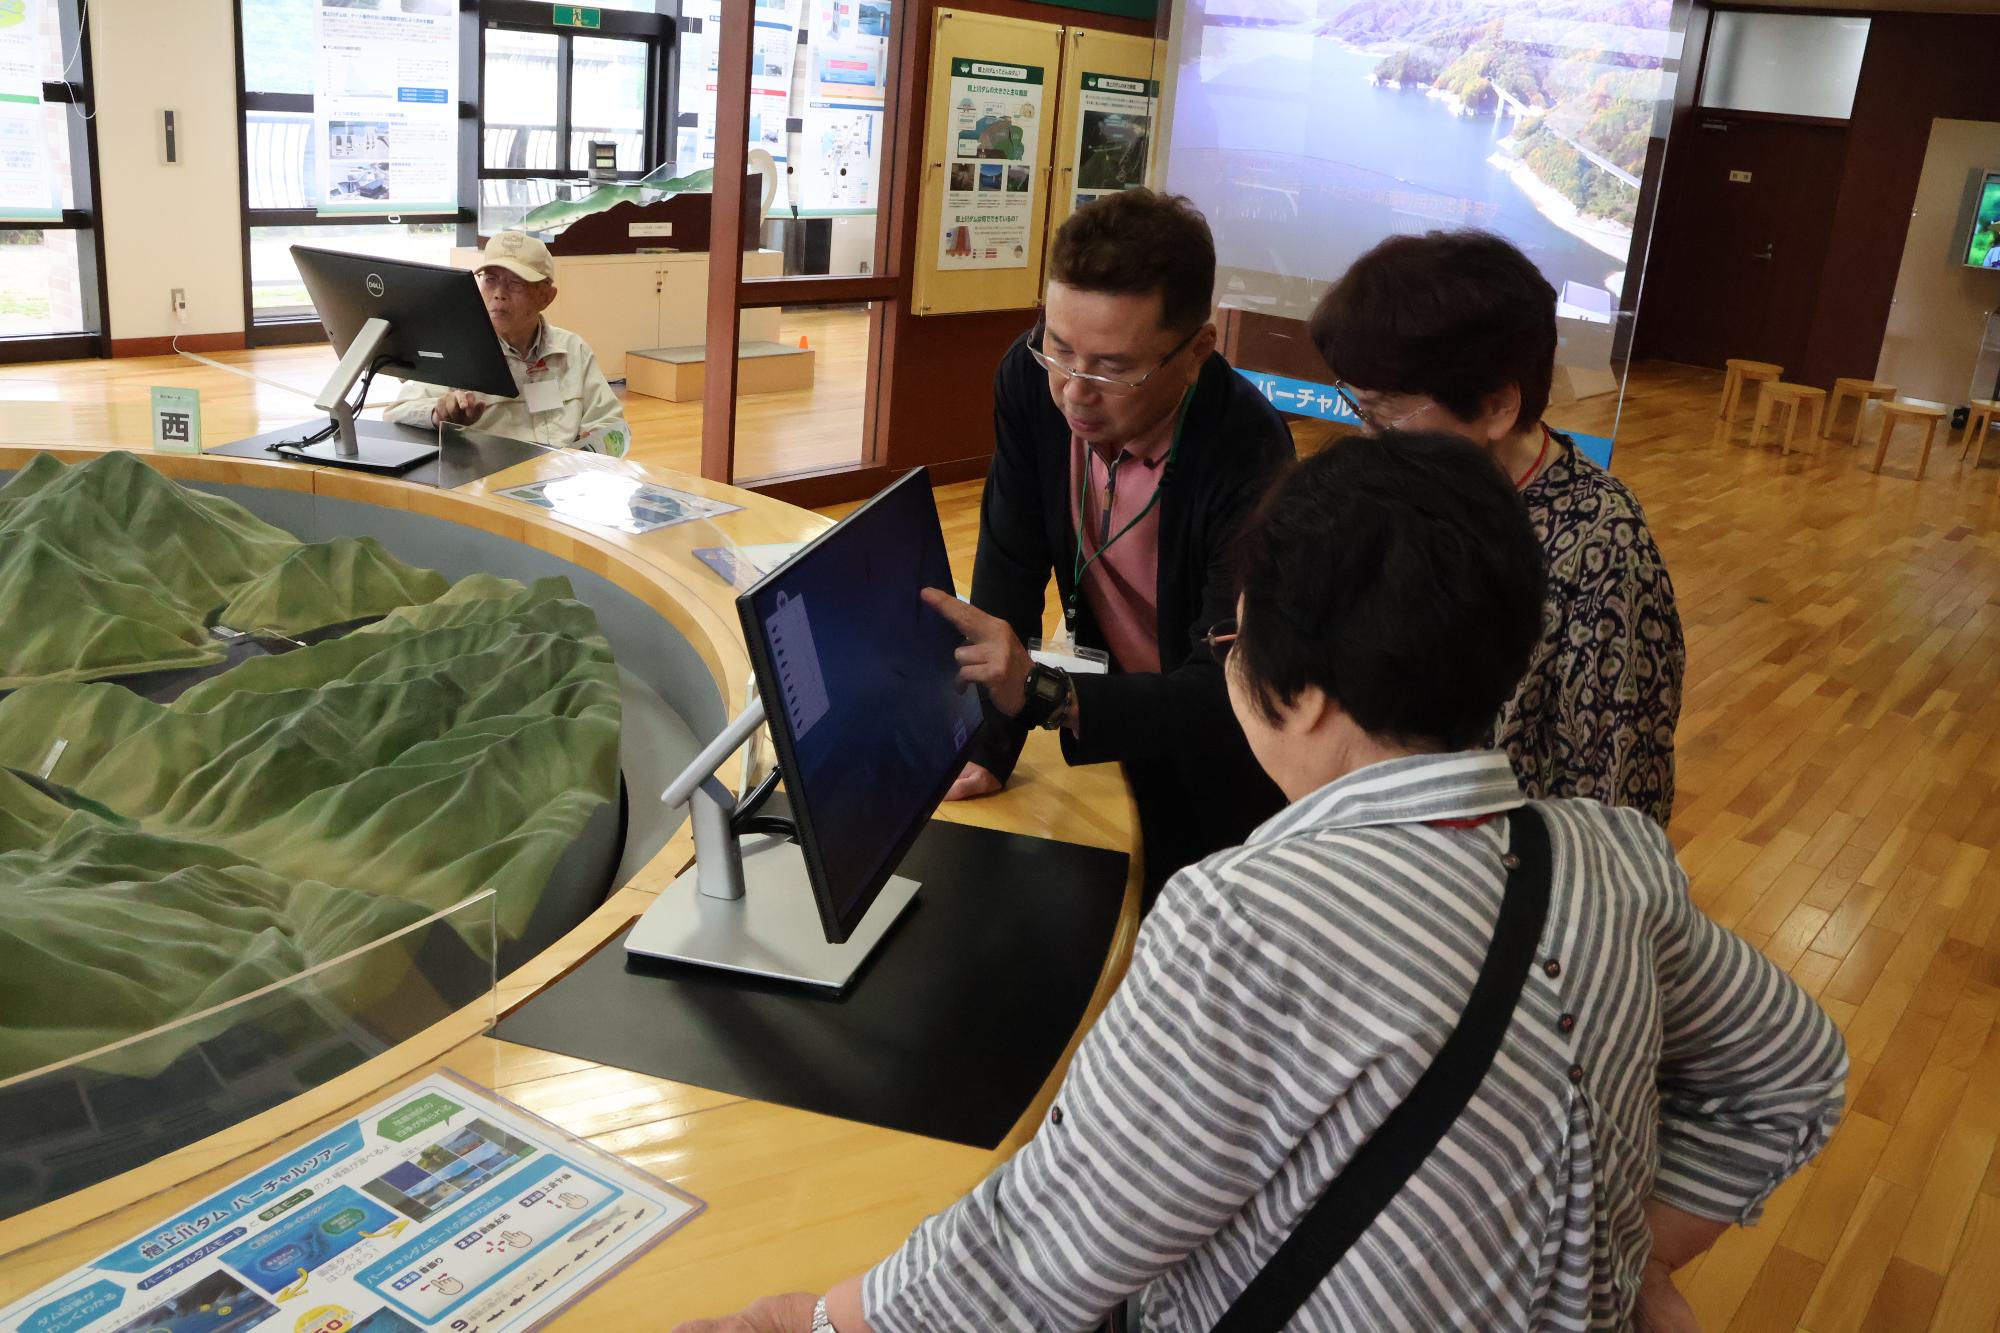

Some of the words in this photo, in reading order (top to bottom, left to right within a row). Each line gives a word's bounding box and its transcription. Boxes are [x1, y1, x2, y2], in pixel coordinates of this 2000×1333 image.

[368, 281, 383, 290] DELL
[1257, 380, 1353, 417] バーチャル
[160, 412, 189, 442] 西
[142, 1211, 229, 1259] 摺上川ダム
[233, 1142, 348, 1209] バーチャルツアー
[144, 1228, 243, 1289] バーチャルダムモード
[40, 1293, 117, 1333] わしくわかる
[451, 1319, 469, 1332] 9
